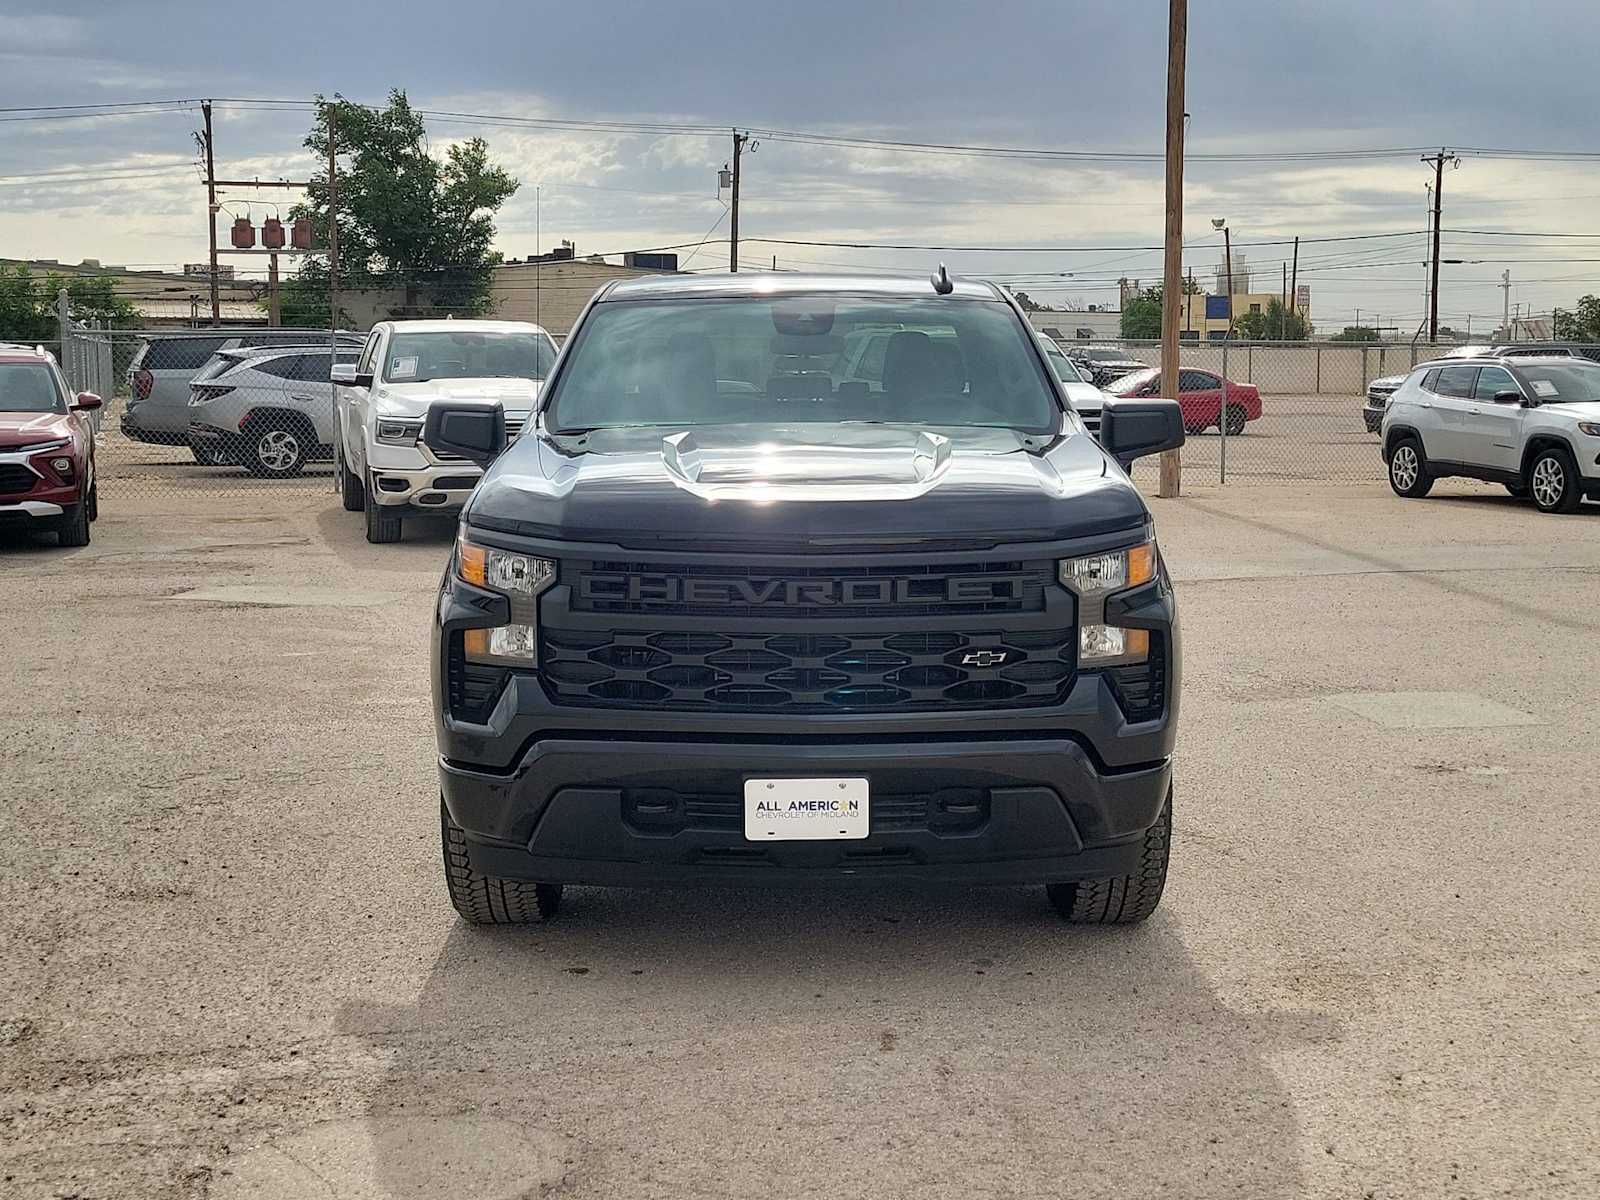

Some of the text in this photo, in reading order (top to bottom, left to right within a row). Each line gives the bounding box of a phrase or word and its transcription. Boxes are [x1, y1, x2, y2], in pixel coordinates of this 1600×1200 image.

[578, 574, 1038, 604] CHEVROLET
[756, 800, 782, 811] ALL
[755, 811, 805, 819] CHEVROLET
[820, 810, 859, 818] MIDLAND
